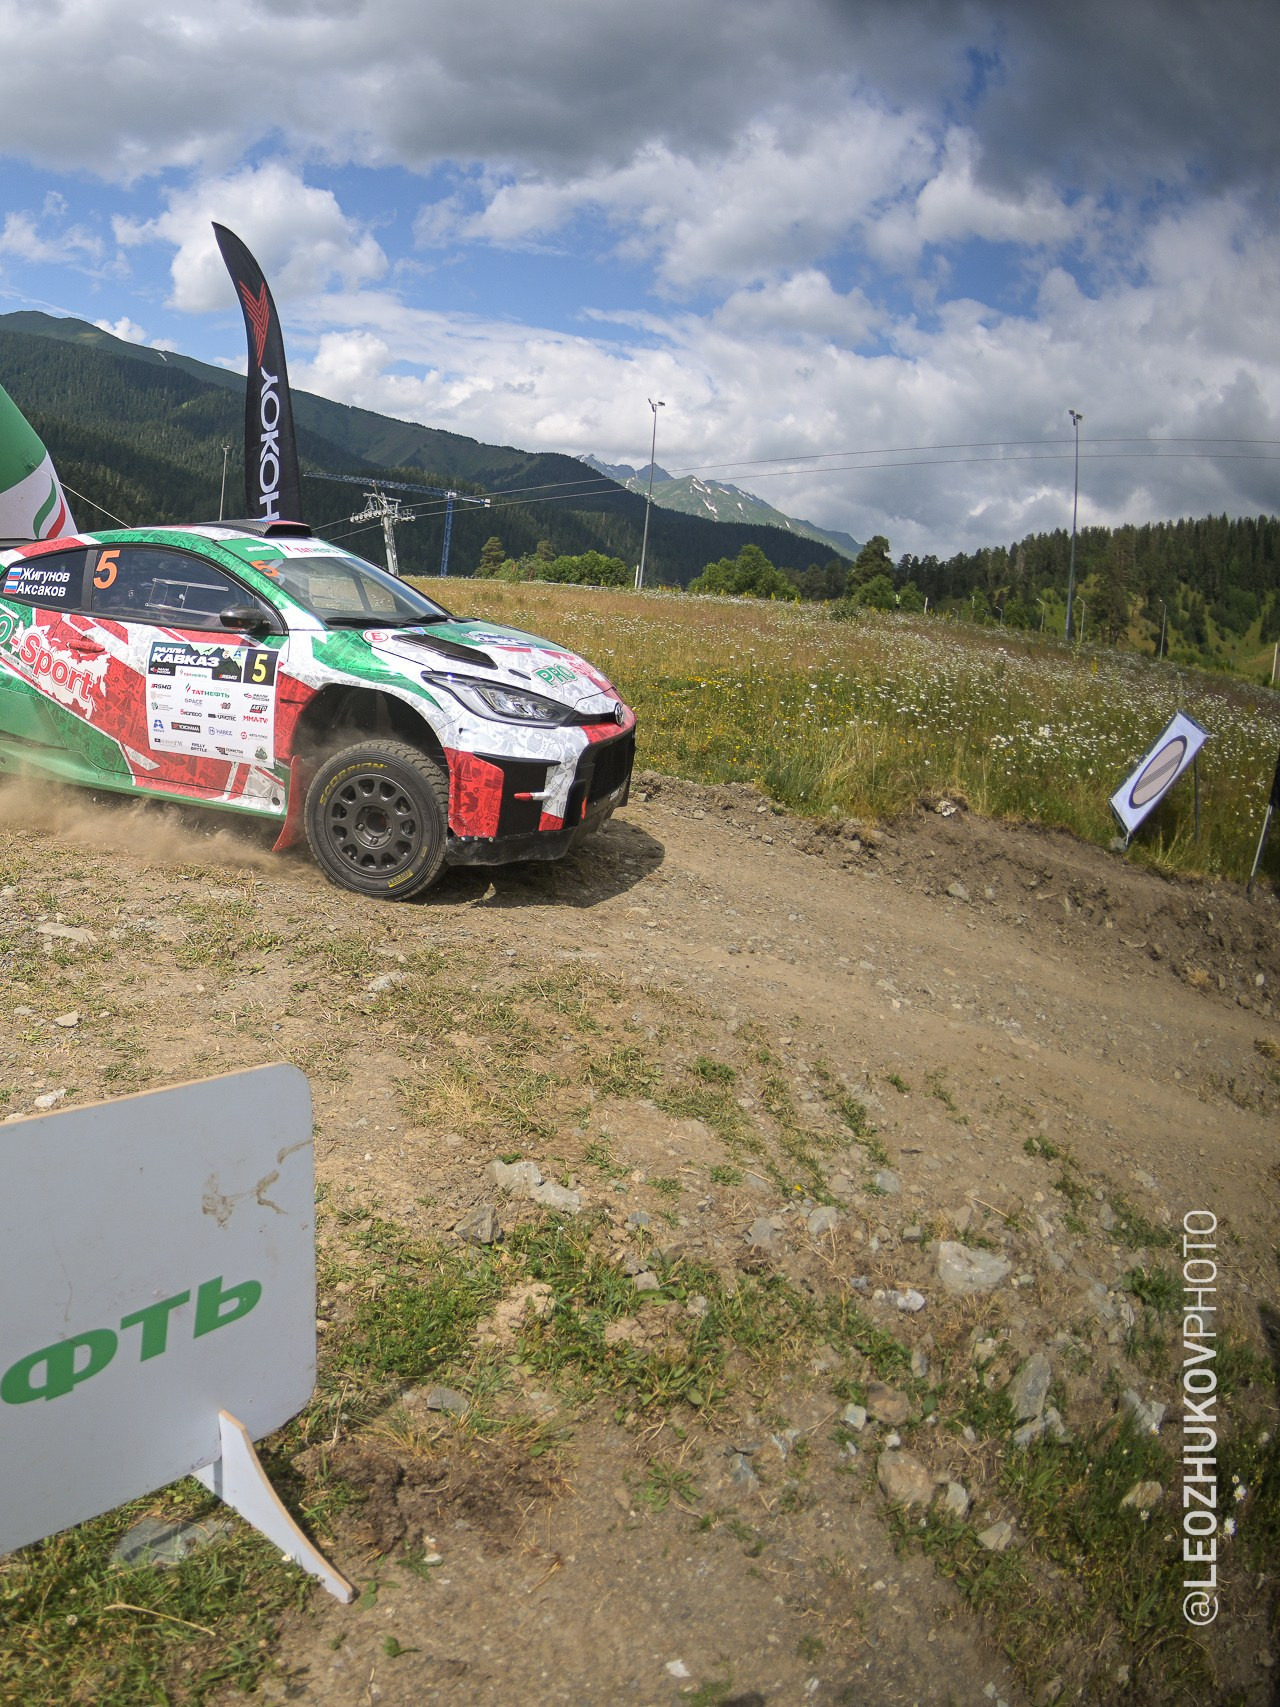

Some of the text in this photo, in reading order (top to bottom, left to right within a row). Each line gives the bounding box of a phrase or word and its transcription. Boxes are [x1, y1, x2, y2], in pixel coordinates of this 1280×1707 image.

[20, 567, 70, 584] Жигунов
[93, 549, 121, 590] 5
[16, 582, 67, 597] Аксаков
[151, 653, 221, 668] КАВКАЗ
[251, 653, 269, 683] 5
[192, 689, 230, 698] ТАТНЕФТЬ
